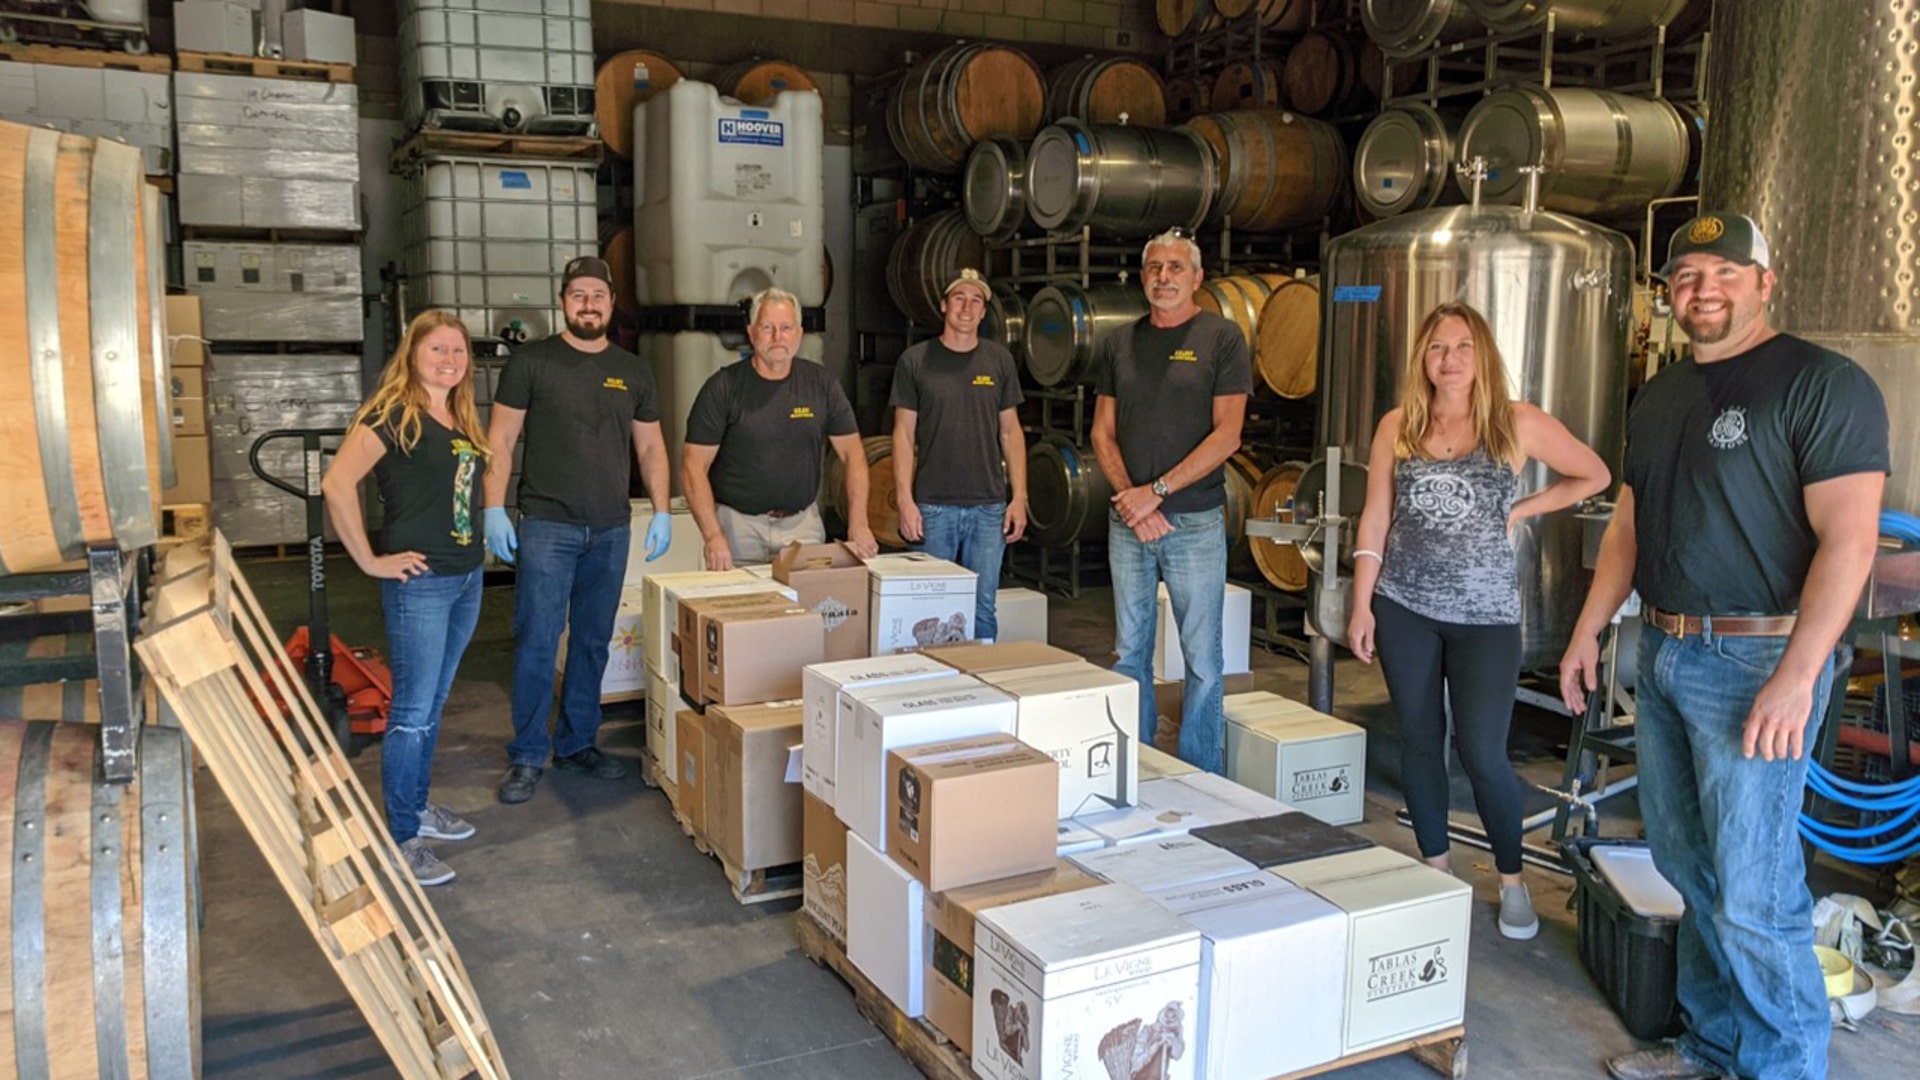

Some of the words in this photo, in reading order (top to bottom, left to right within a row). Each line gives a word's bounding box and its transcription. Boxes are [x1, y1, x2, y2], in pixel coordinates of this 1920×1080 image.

[737, 121, 782, 134] HOOVER
[309, 536, 325, 592] TOYOTA
[1293, 771, 1328, 784] TABLAS
[1292, 780, 1328, 794] CREEK
[1222, 878, 1265, 894] GLASS
[1369, 951, 1418, 974] TABLAS
[1367, 967, 1417, 990] CREEK
